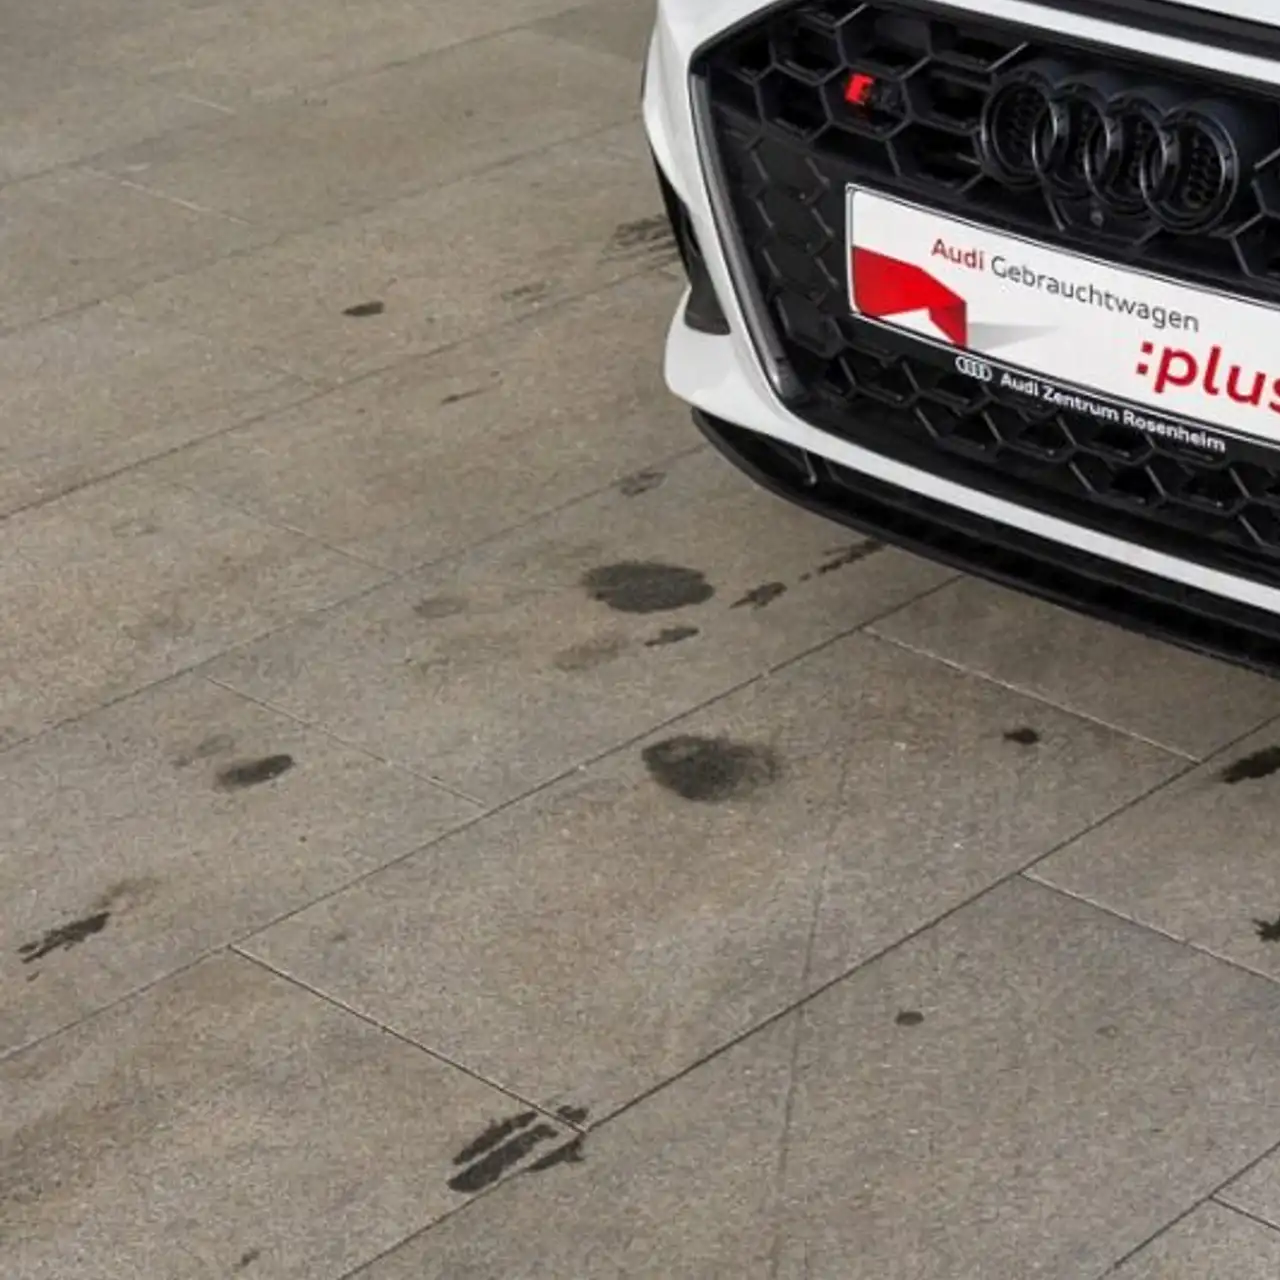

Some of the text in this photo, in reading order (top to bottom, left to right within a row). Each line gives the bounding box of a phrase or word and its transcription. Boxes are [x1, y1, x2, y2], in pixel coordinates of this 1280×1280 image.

[931, 237, 1200, 333] Audi Gebrauchtwagen
[1000, 373, 1226, 454] Audi Zentrum Rosenheim
